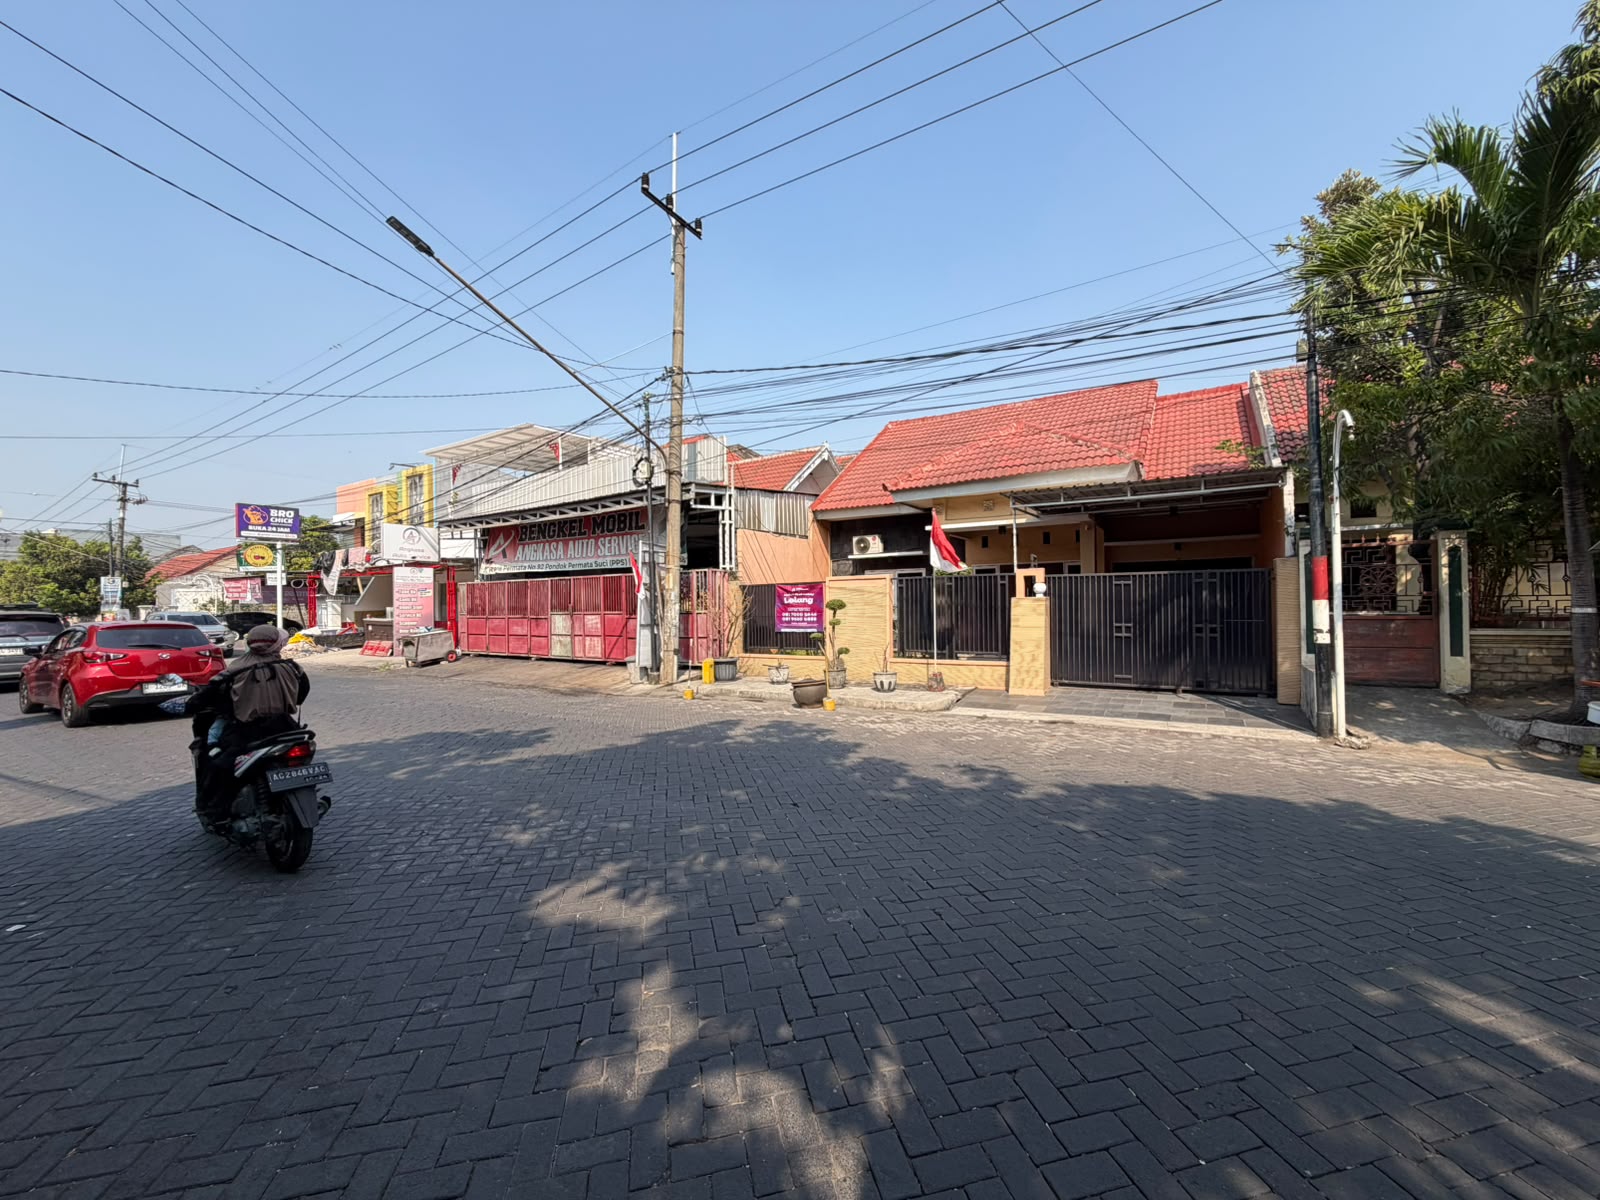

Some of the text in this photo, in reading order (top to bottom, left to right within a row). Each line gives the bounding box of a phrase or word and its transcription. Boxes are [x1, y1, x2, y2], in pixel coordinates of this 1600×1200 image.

[269, 508, 295, 519] BRO
[518, 510, 646, 542] BENGKEL MOBIL
[514, 541, 565, 561] ANGKASA
[567, 538, 595, 559] AUTO
[545, 562, 567, 570] Pondok
[567, 561, 593, 569] Permata
[594, 559, 608, 568] Suci
[609, 558, 628, 567] (PPS)
